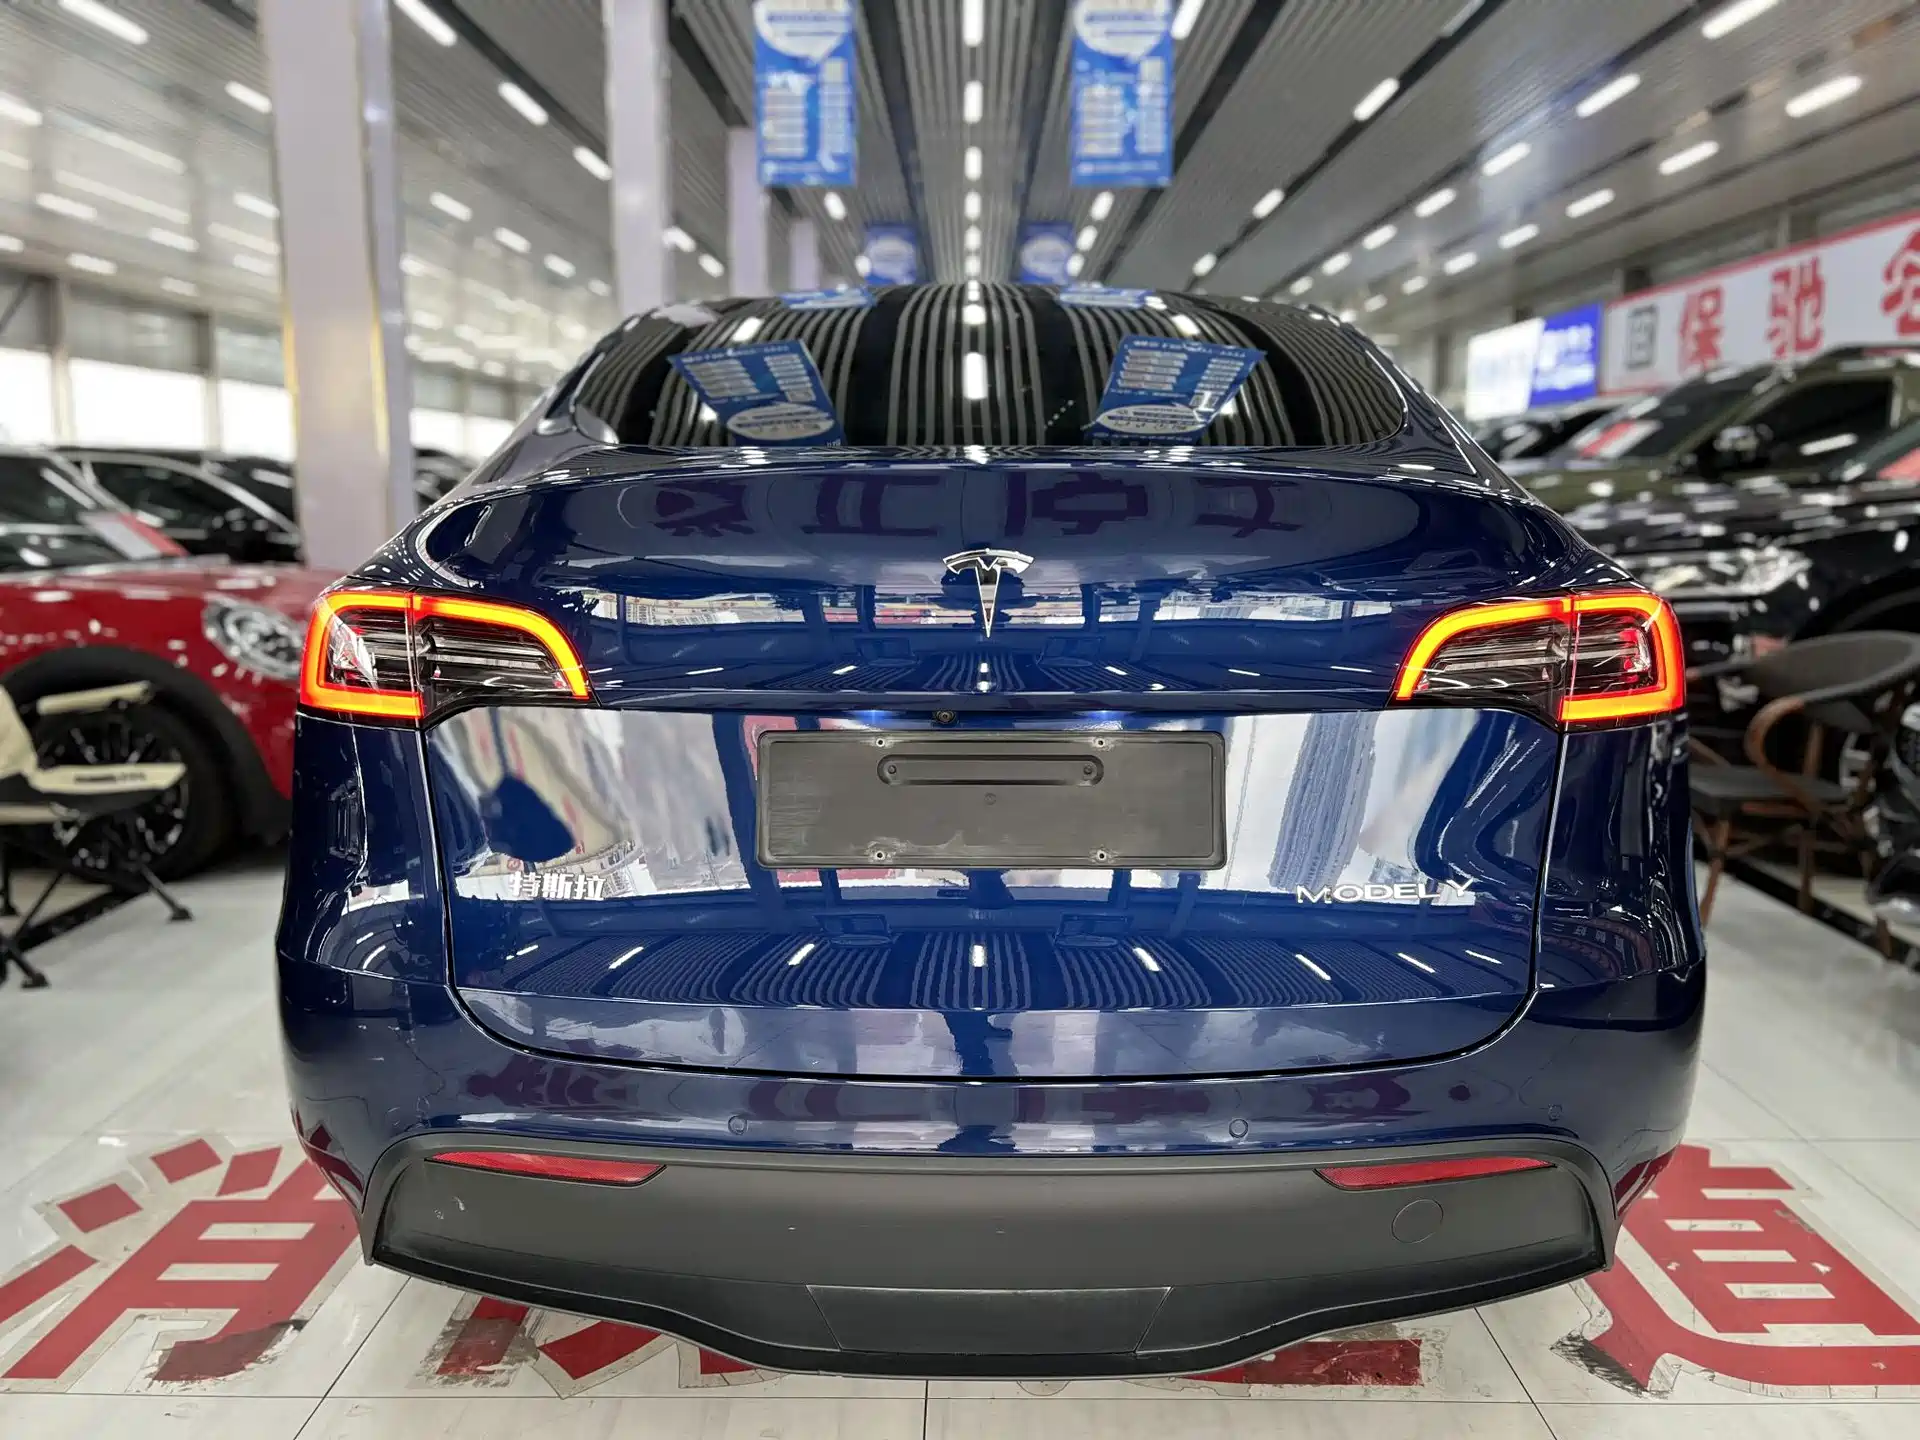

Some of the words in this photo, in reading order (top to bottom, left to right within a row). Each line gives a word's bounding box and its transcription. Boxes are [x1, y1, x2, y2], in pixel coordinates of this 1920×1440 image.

[509, 871, 606, 900] 特斯拉
[1296, 883, 1440, 904] MODEL
[1446, 877, 1475, 897] Y
